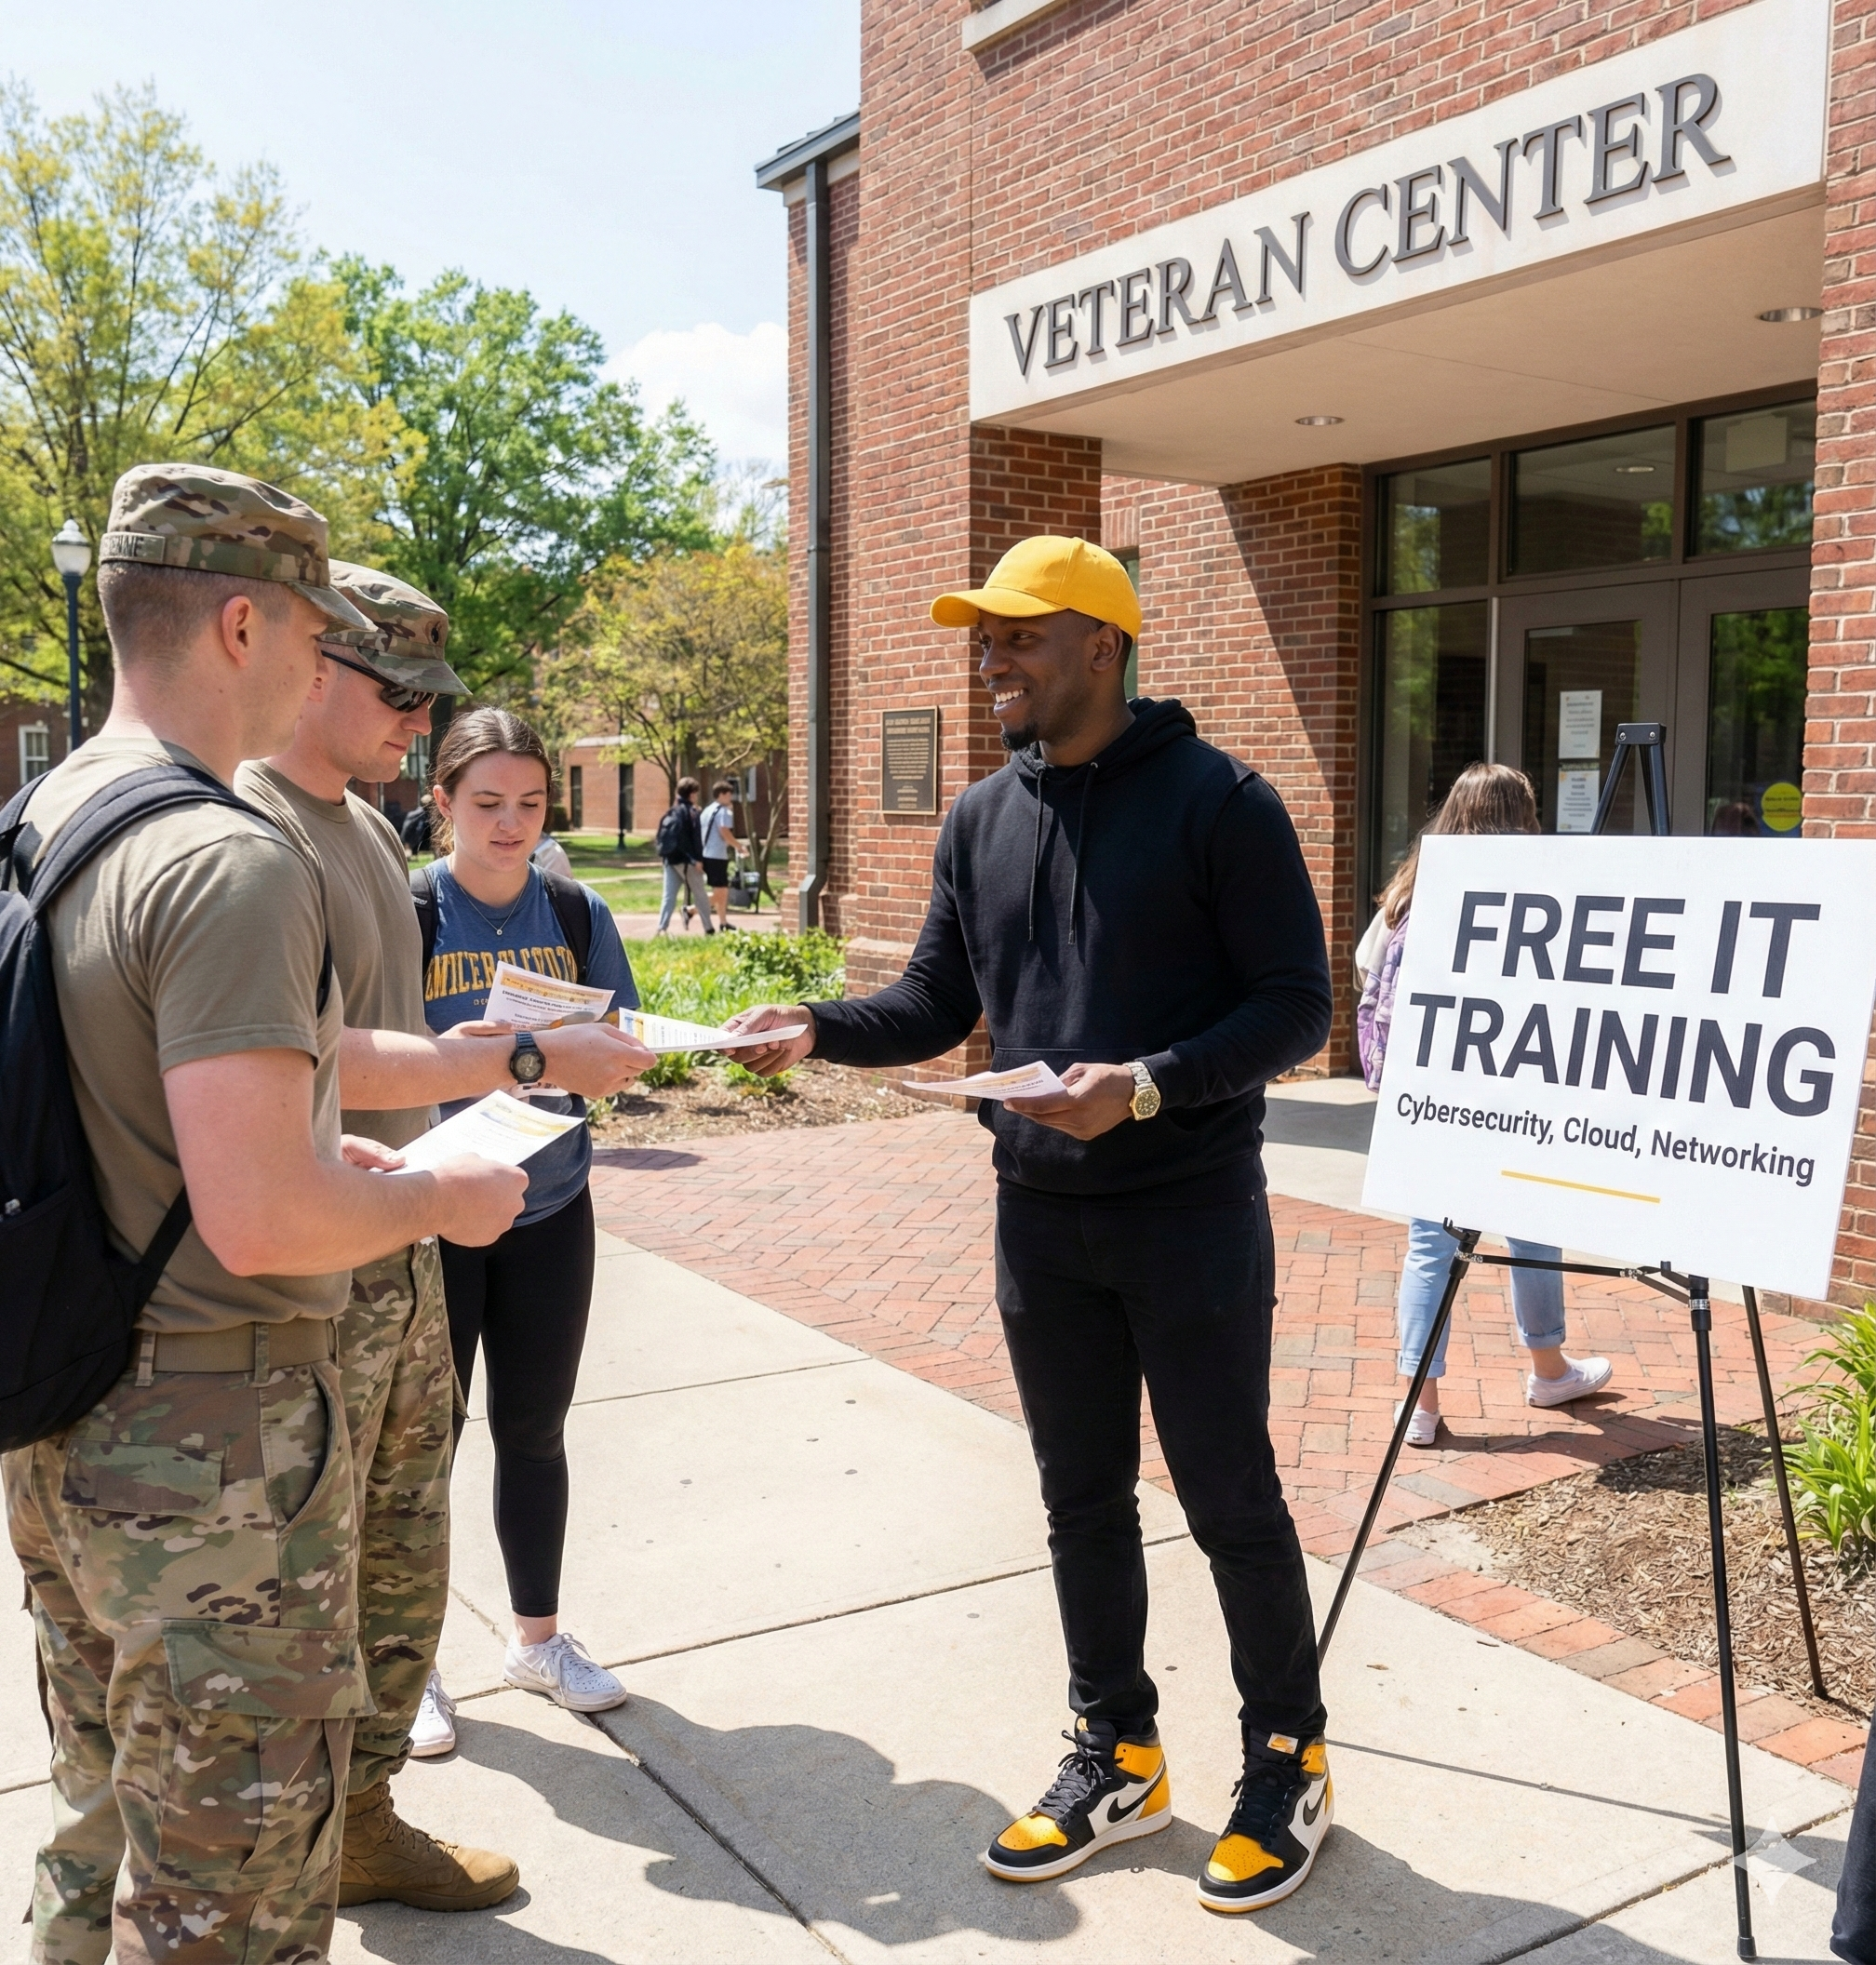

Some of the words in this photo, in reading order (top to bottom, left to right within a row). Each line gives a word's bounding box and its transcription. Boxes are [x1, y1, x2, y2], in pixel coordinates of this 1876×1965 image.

[1003, 211, 1311, 377] VETERAN
[1334, 73, 1732, 277] CENTER
[1451, 890, 1686, 990] FREE
[1710, 901, 1822, 998] IT
[1409, 992, 1836, 1117] TRAINING
[1397, 1092, 1554, 1145] Cybersecurity,
[1563, 1116, 1642, 1159] Cloud,
[1651, 1129, 1816, 1187] Networking
